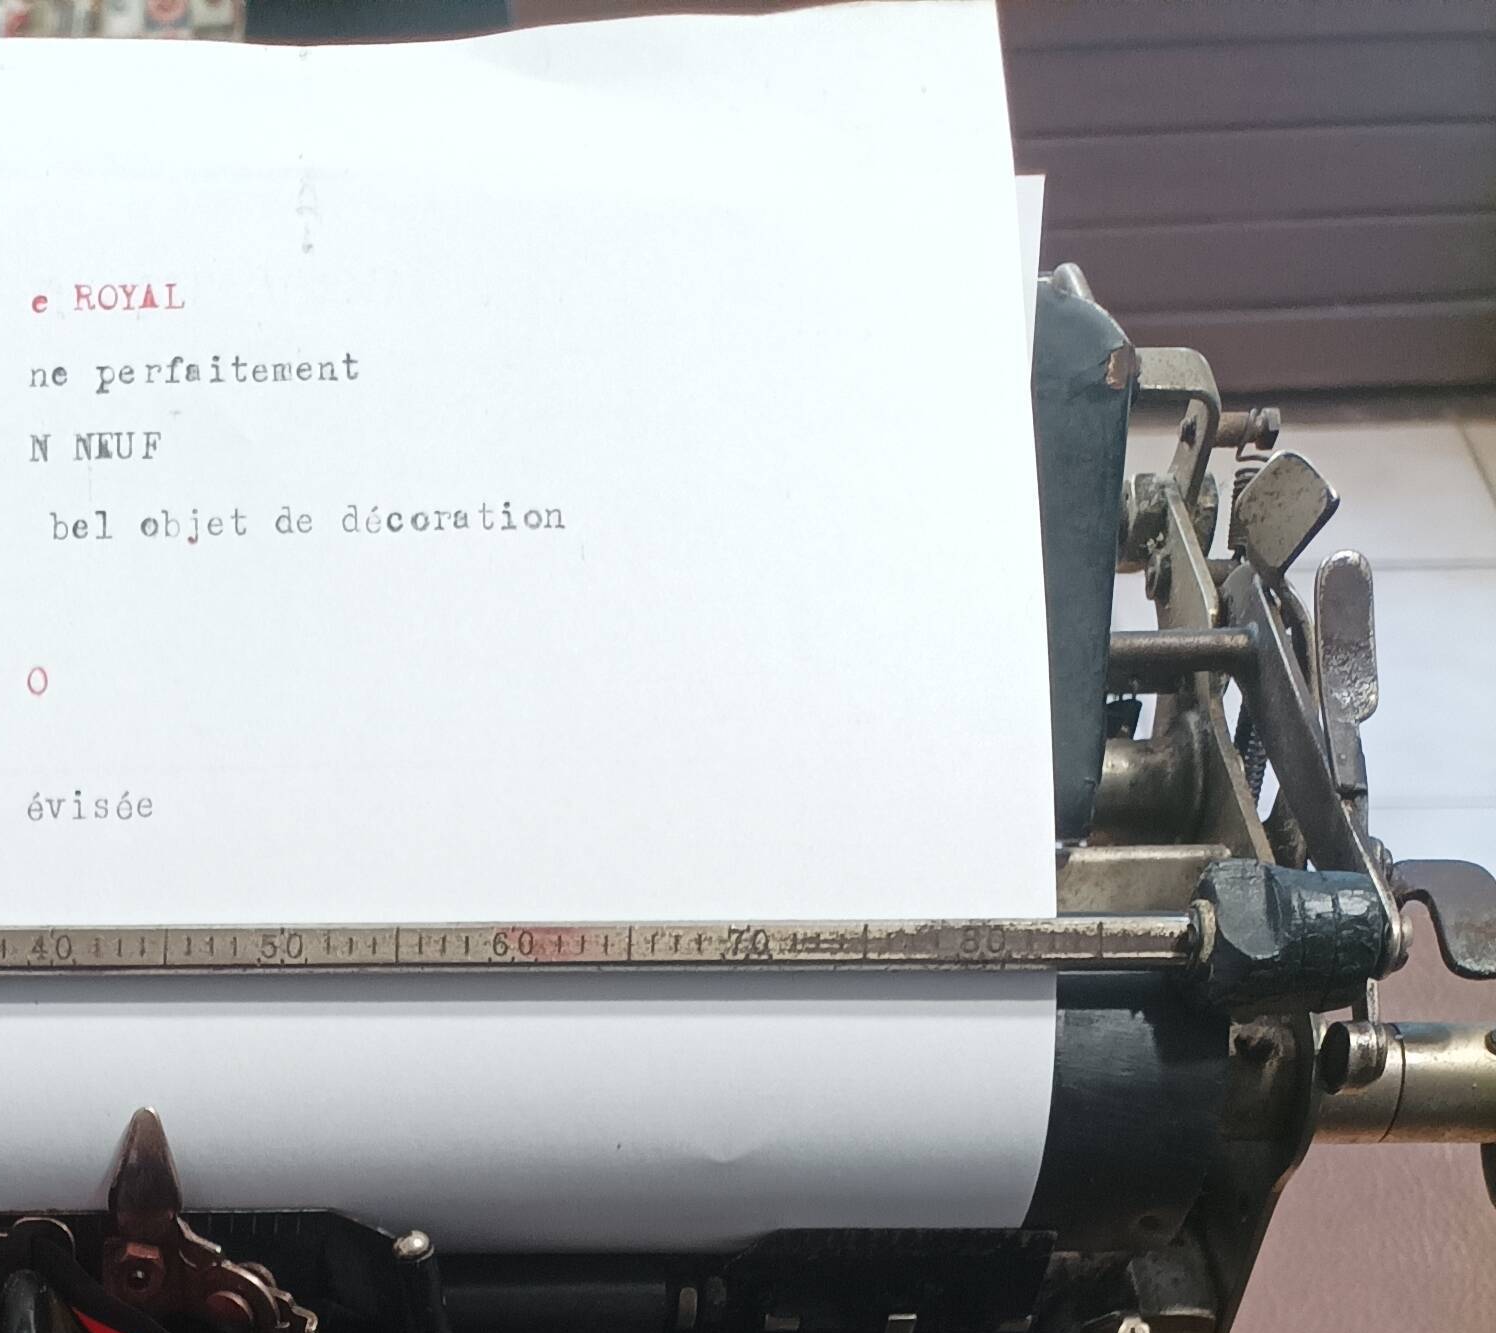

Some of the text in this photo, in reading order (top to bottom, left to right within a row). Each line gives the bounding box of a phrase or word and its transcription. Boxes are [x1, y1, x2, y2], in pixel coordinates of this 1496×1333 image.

[32, 295, 48, 313] e
[75, 283, 185, 310] ROYAL
[28, 364, 69, 388] ne
[30, 434, 51, 462] N
[74, 432, 161, 460] NEUF
[49, 510, 112, 540] bel
[140, 508, 246, 544] objet
[275, 506, 312, 534] de
[342, 501, 565, 533] décoration
[27, 667, 48, 696] 0
[28, 790, 152, 821] évisée
[31, 935, 75, 960] 40
[260, 932, 304, 959] 50
[492, 930, 535, 957] 60
